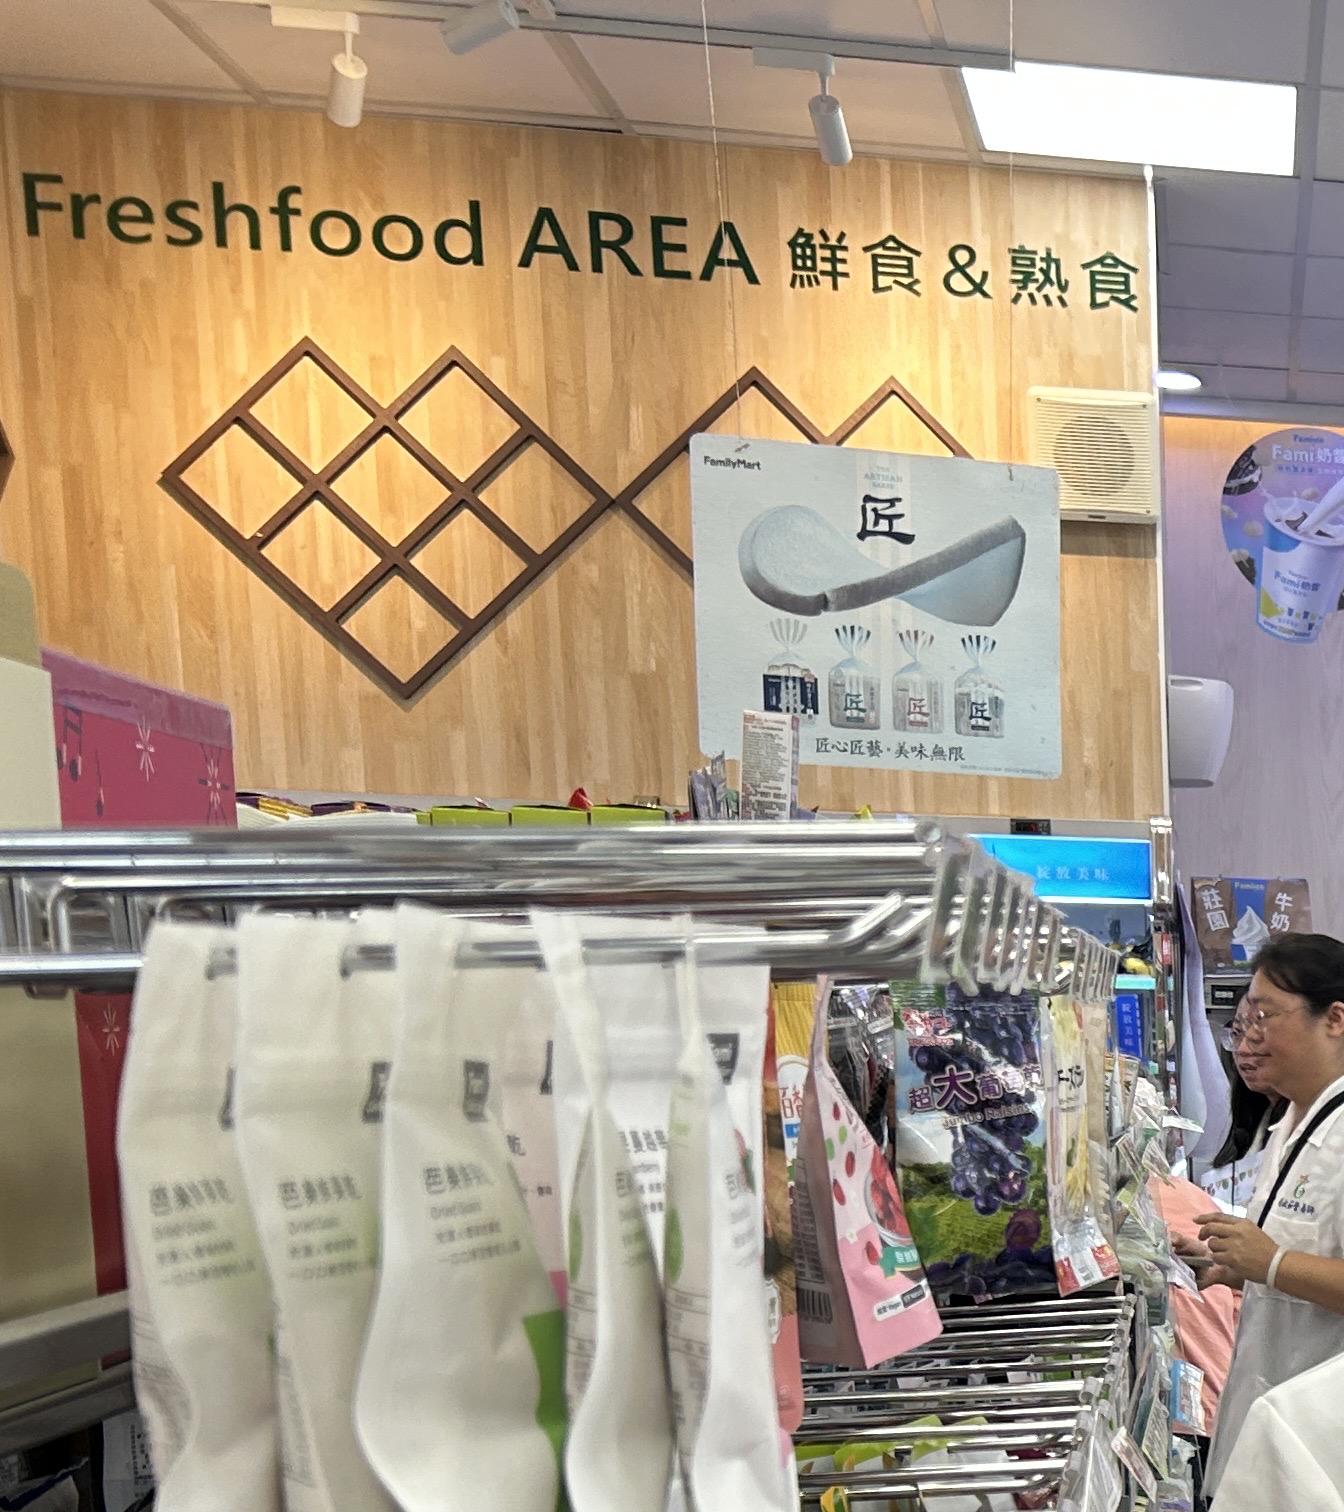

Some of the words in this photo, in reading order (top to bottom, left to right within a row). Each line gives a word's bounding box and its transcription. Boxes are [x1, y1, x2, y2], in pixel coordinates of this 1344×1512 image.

[22, 171, 485, 267] Freshfood
[518, 206, 761, 285] AREA
[703, 455, 762, 471] FamilyMart
[1270, 891, 1293, 932] 牛奶
